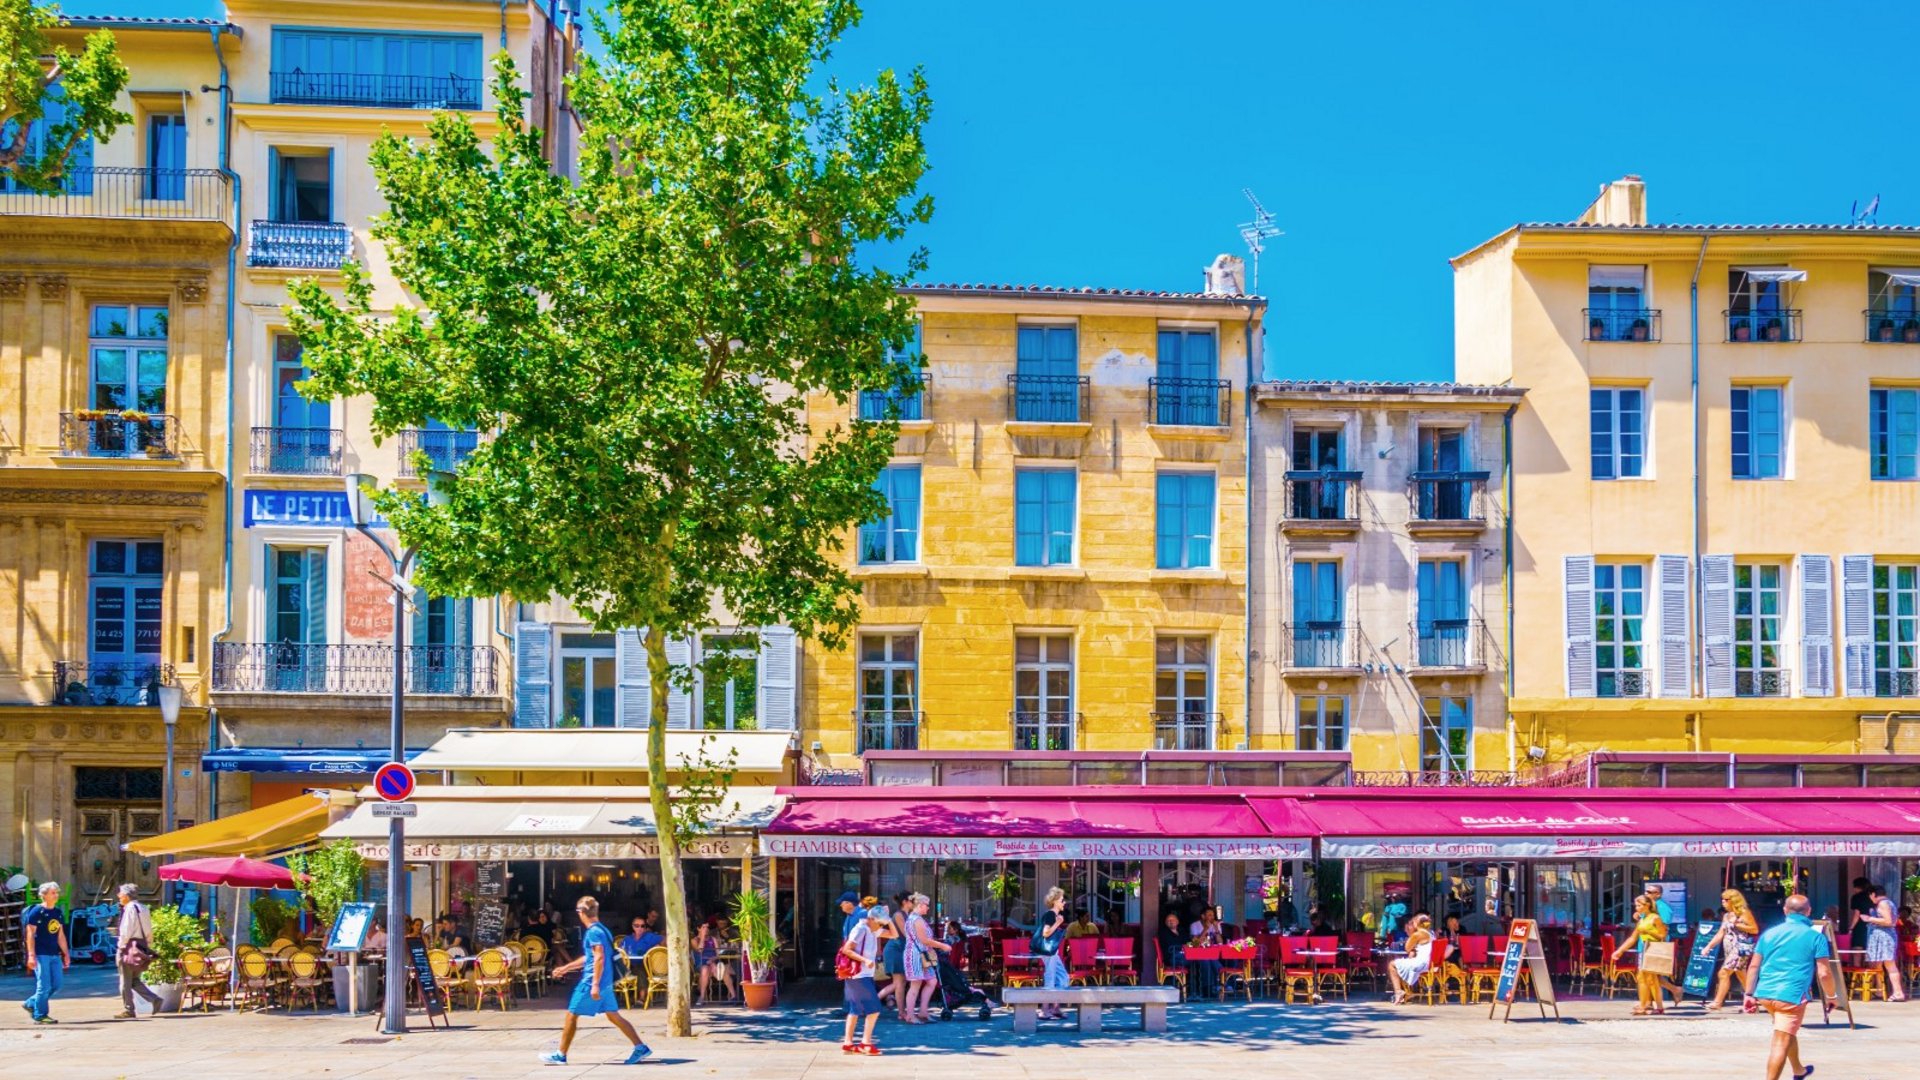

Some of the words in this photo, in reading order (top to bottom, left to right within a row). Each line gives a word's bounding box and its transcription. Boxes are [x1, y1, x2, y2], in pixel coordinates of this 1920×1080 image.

[251, 495, 275, 520] LE
[284, 496, 345, 522] PETIT
[460, 843, 613, 857] RESTAURANT
[685, 840, 730, 854] Café
[769, 840, 873, 854] CHAMBRES
[876, 844, 894, 855] de
[898, 841, 979, 856] CHARME
[1081, 843, 1177, 857] BRASSERIE
[1182, 843, 1302, 857] RESTAURANT
[1379, 841, 1430, 854] Service
[1683, 840, 1759, 854] GLACIER
